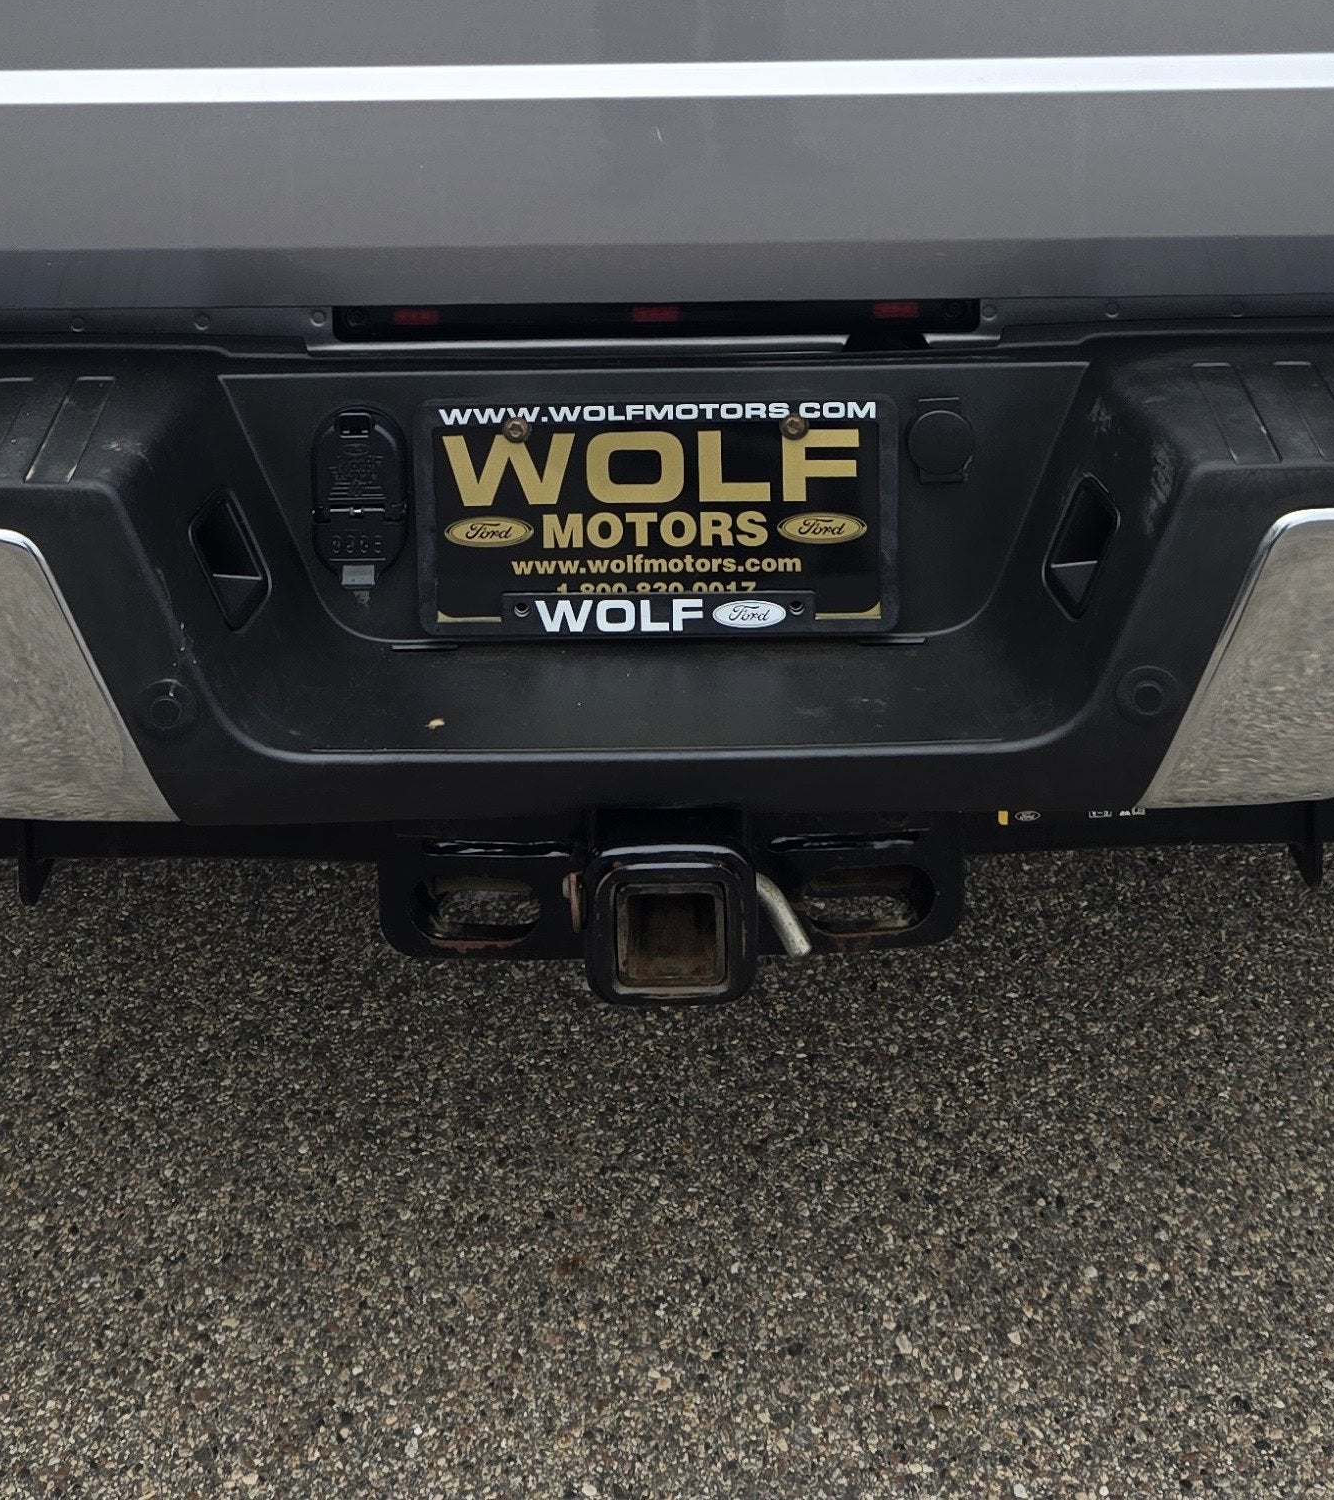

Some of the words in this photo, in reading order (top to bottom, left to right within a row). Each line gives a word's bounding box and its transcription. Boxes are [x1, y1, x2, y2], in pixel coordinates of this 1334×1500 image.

[438, 401, 877, 426] WWW.WOLFMOTORSCOM
[442, 428, 860, 507] WOLF
[465, 522, 512, 540] Ford
[542, 510, 769, 549] MOTORS
[797, 518, 846, 536] Ford
[511, 553, 802, 576] www.wolfmotors.com
[534, 598, 704, 633] WOLF
[728, 603, 771, 624] Ford
